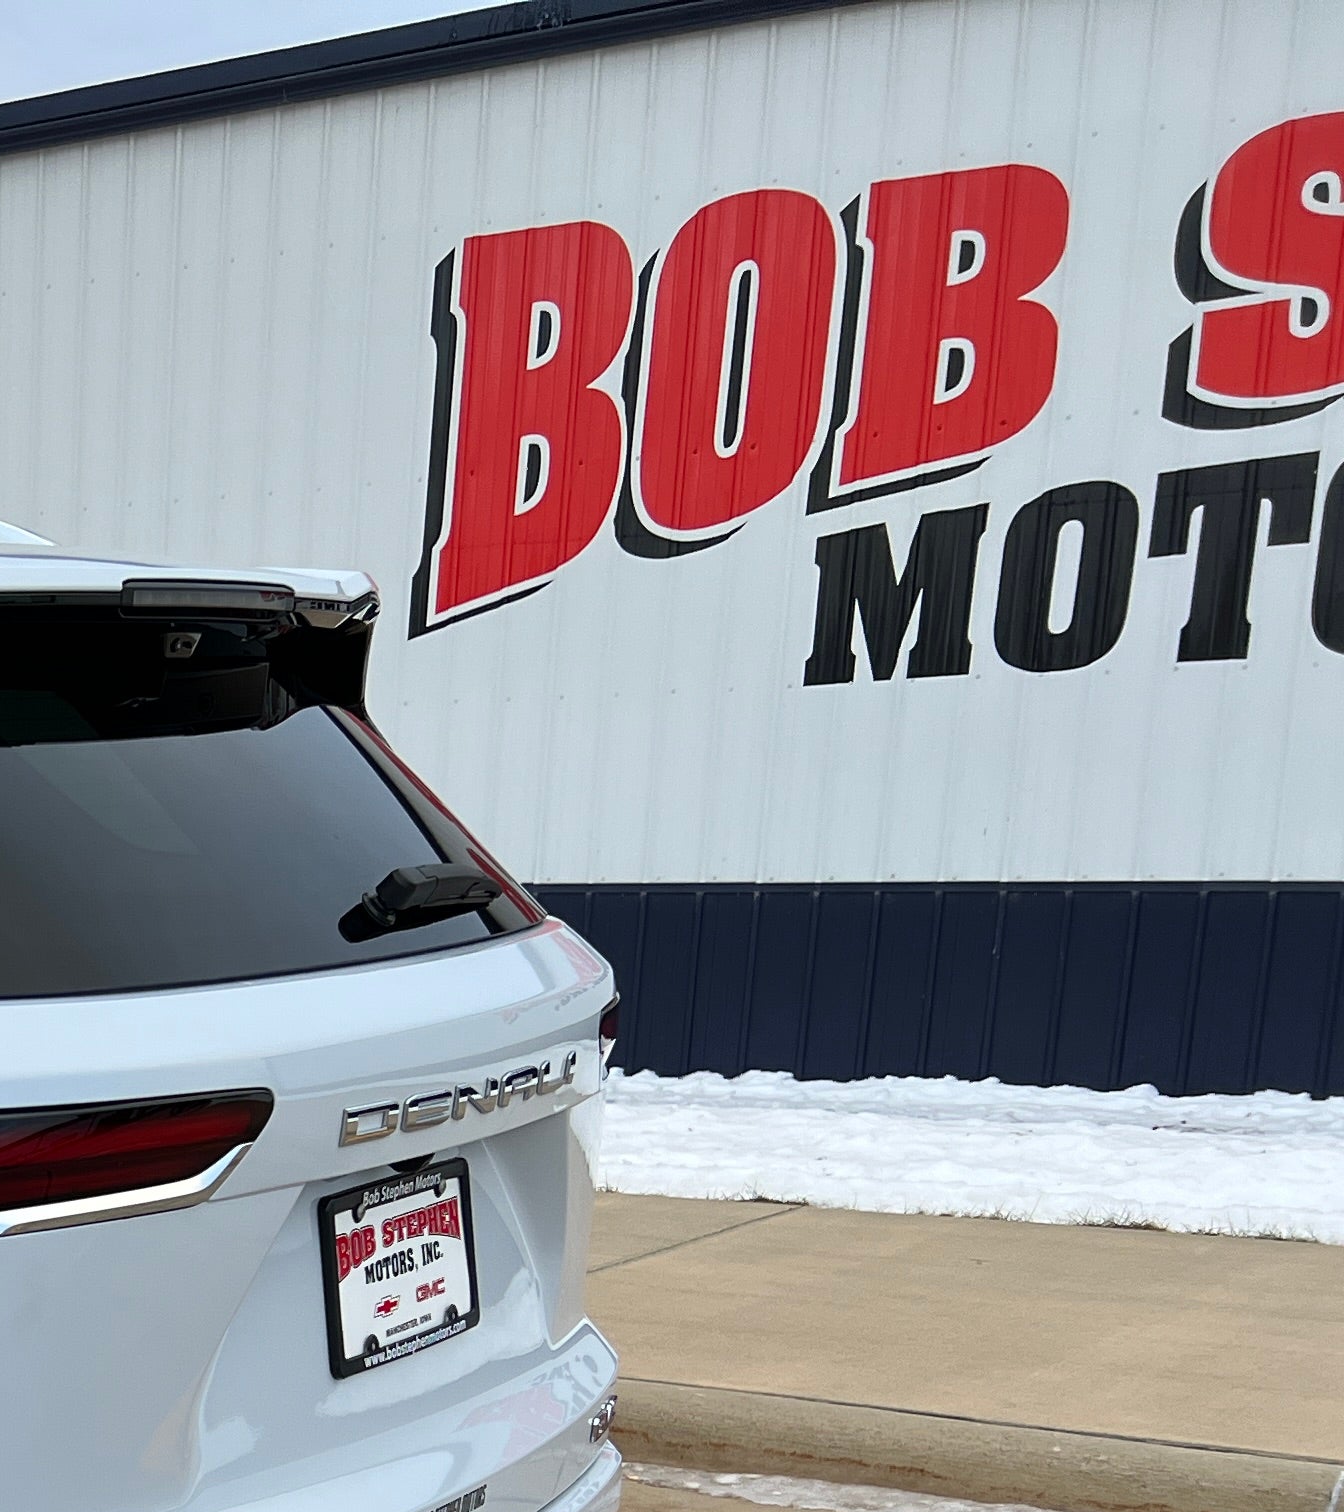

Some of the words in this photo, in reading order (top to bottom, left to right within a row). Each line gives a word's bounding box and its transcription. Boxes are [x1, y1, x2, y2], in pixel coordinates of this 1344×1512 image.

[409, 163, 1070, 640] BOB
[803, 451, 1344, 688] MOT
[338, 1050, 577, 1147] DENALI
[362, 1187, 381, 1207] Bob
[381, 1180, 414, 1202] Stephen
[415, 1172, 442, 1192] Motors
[335, 1223, 377, 1282] BOB
[382, 1195, 462, 1248] STEPHEN
[364, 1247, 419, 1284] MOTORS,
[421, 1240, 444, 1266] INC.
[415, 1277, 446, 1303] GMC
